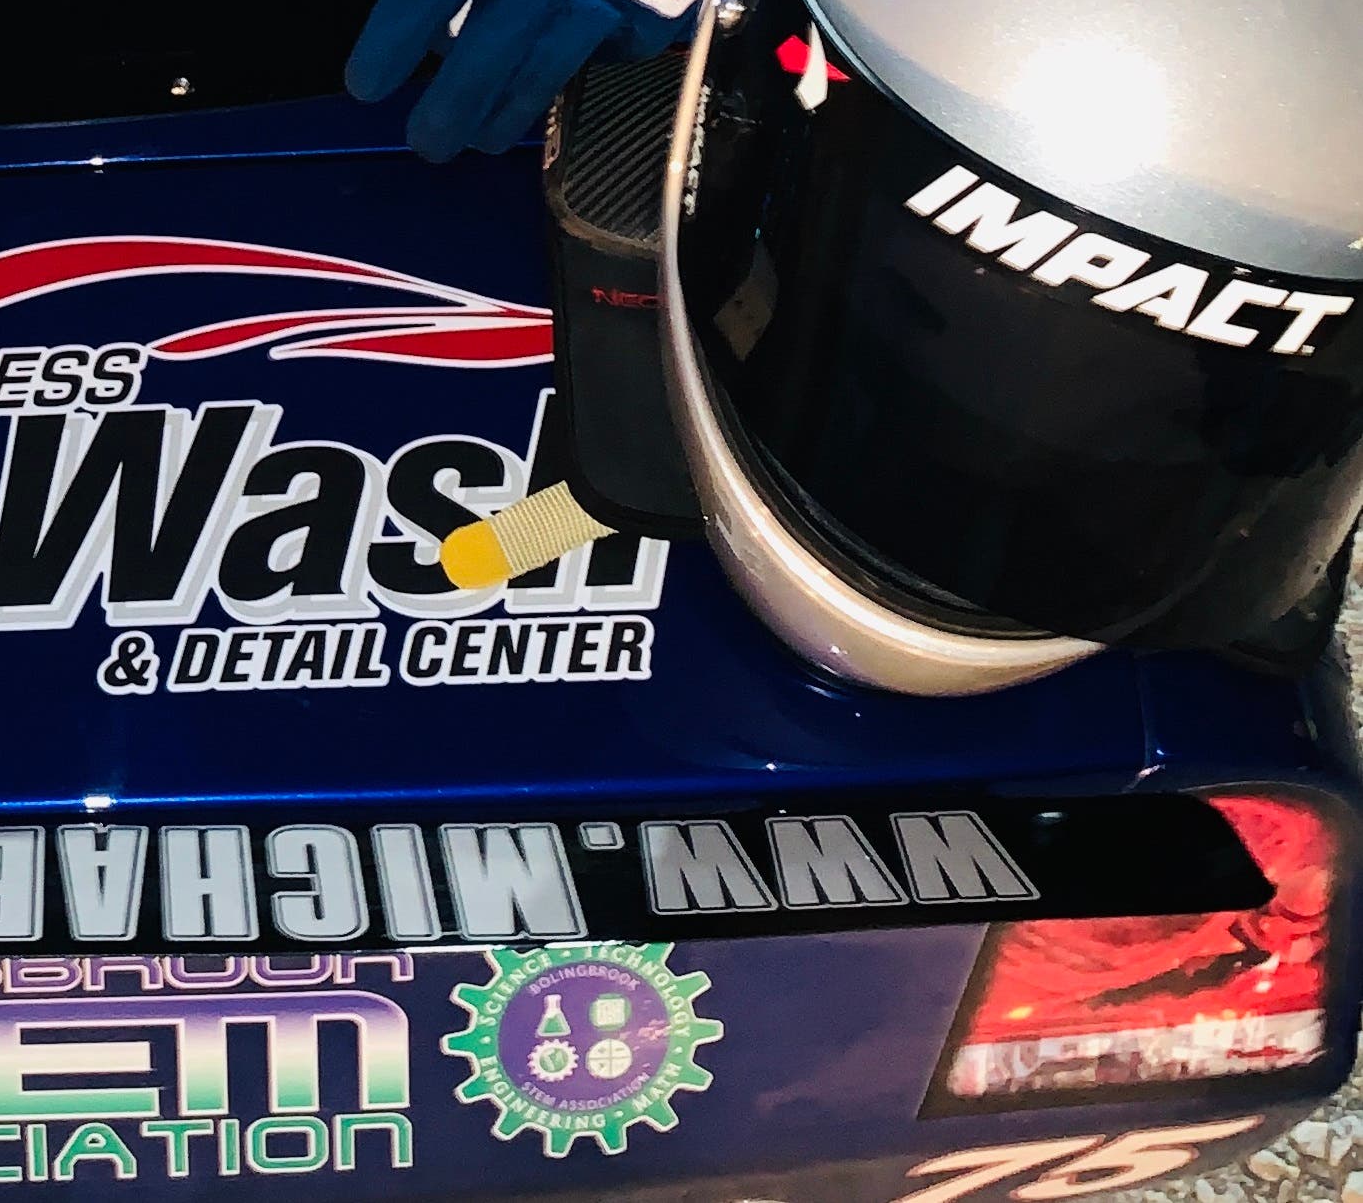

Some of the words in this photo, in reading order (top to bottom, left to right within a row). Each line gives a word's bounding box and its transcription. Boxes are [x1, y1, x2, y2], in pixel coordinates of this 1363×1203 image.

[98, 629, 158, 695] &
[168, 621, 391, 690] DETAIL
[399, 615, 654, 687] CENTER
[477, 953, 553, 1026] SCIENCE
[583, 944, 691, 1038] TECHNOLOGY
[528, 964, 641, 996] BOLINGBROOK
[480, 1055, 607, 1129] ENGINEERING
[632, 1062, 683, 1113] MATH
[521, 1081, 556, 1107] STEM
[558, 1072, 650, 1112] ASSOCIATION
